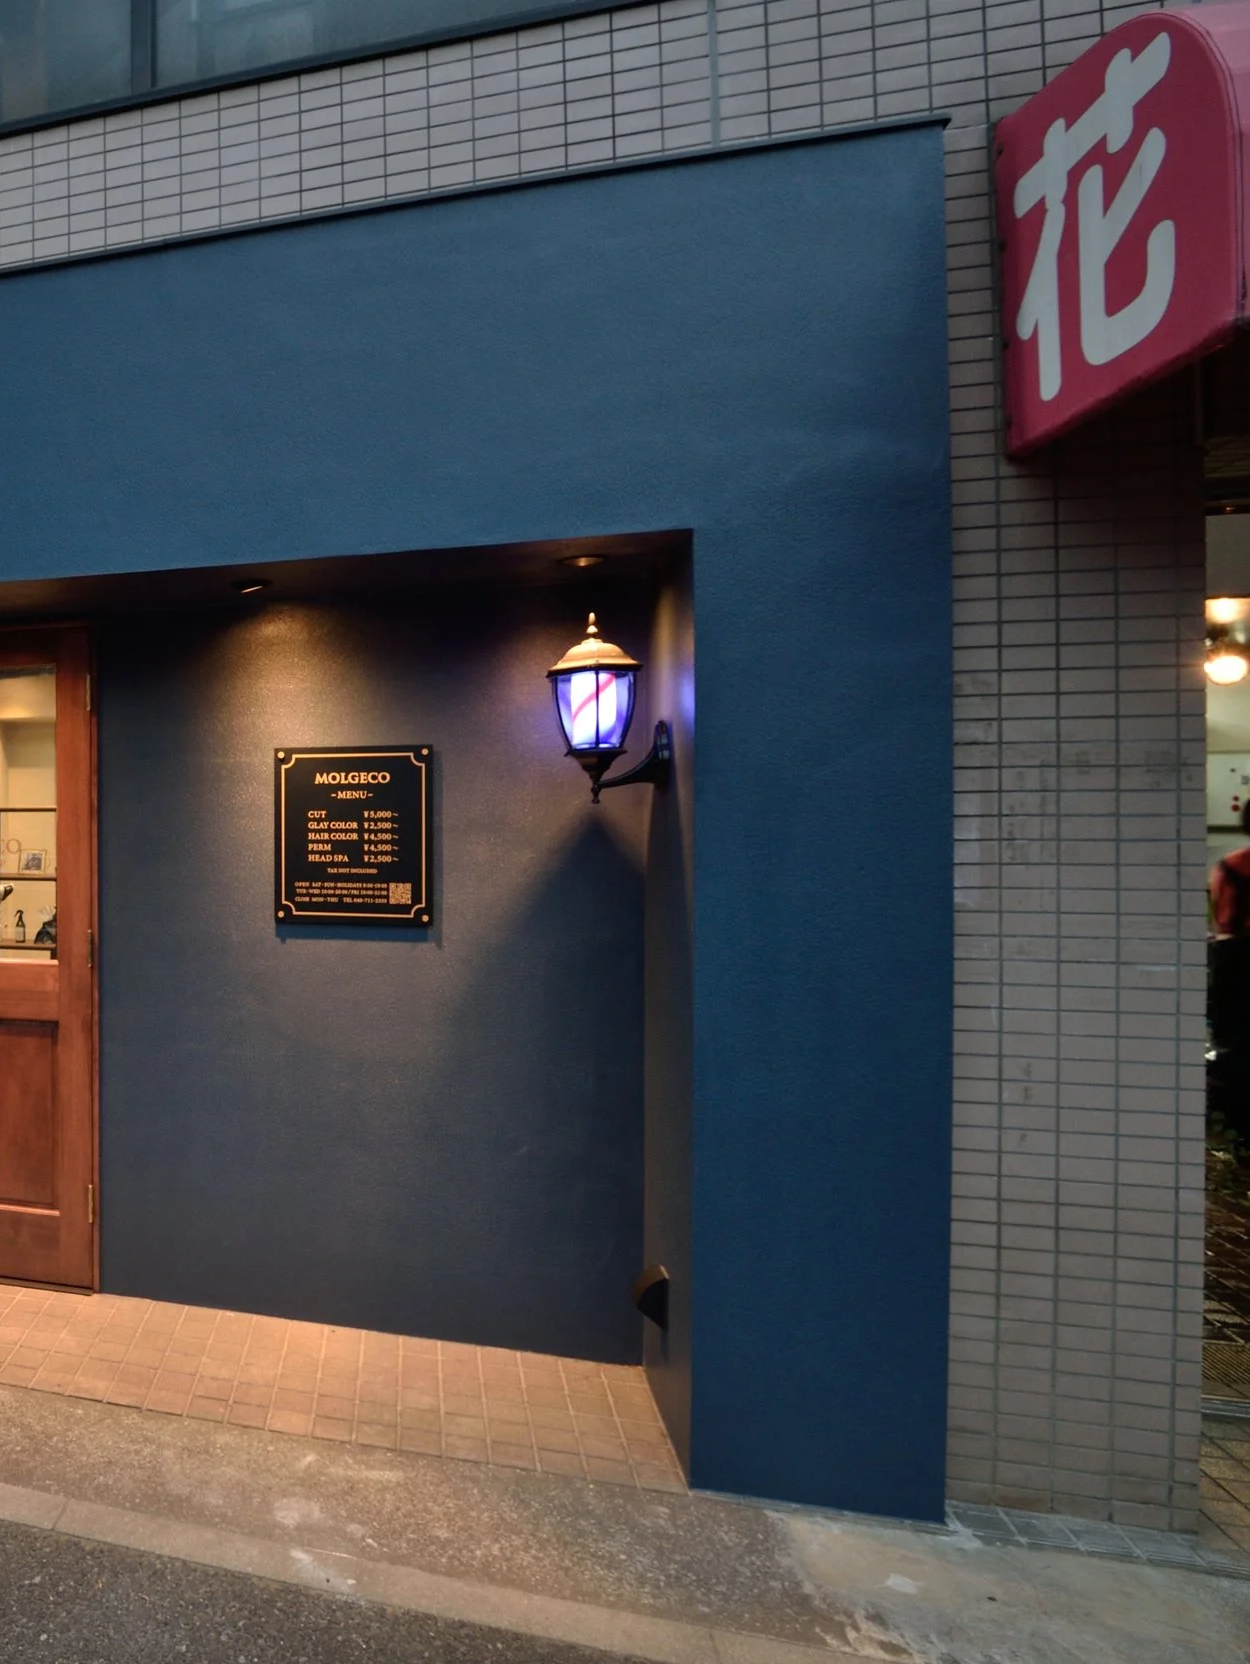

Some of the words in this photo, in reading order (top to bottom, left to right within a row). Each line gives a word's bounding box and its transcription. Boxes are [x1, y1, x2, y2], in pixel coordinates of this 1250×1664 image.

[1013, 31, 1176, 402] 花
[314, 771, 391, 785] MOLGECO
[307, 810, 327, 819] CUT
[307, 821, 329, 829] GLAY
[330, 821, 359, 829] COLOR
[307, 832, 330, 840] HAIR
[330, 832, 359, 840] COLOR
[307, 843, 332, 851] PERM
[307, 854, 333, 862] HEAD
[333, 854, 350, 862] SPA
